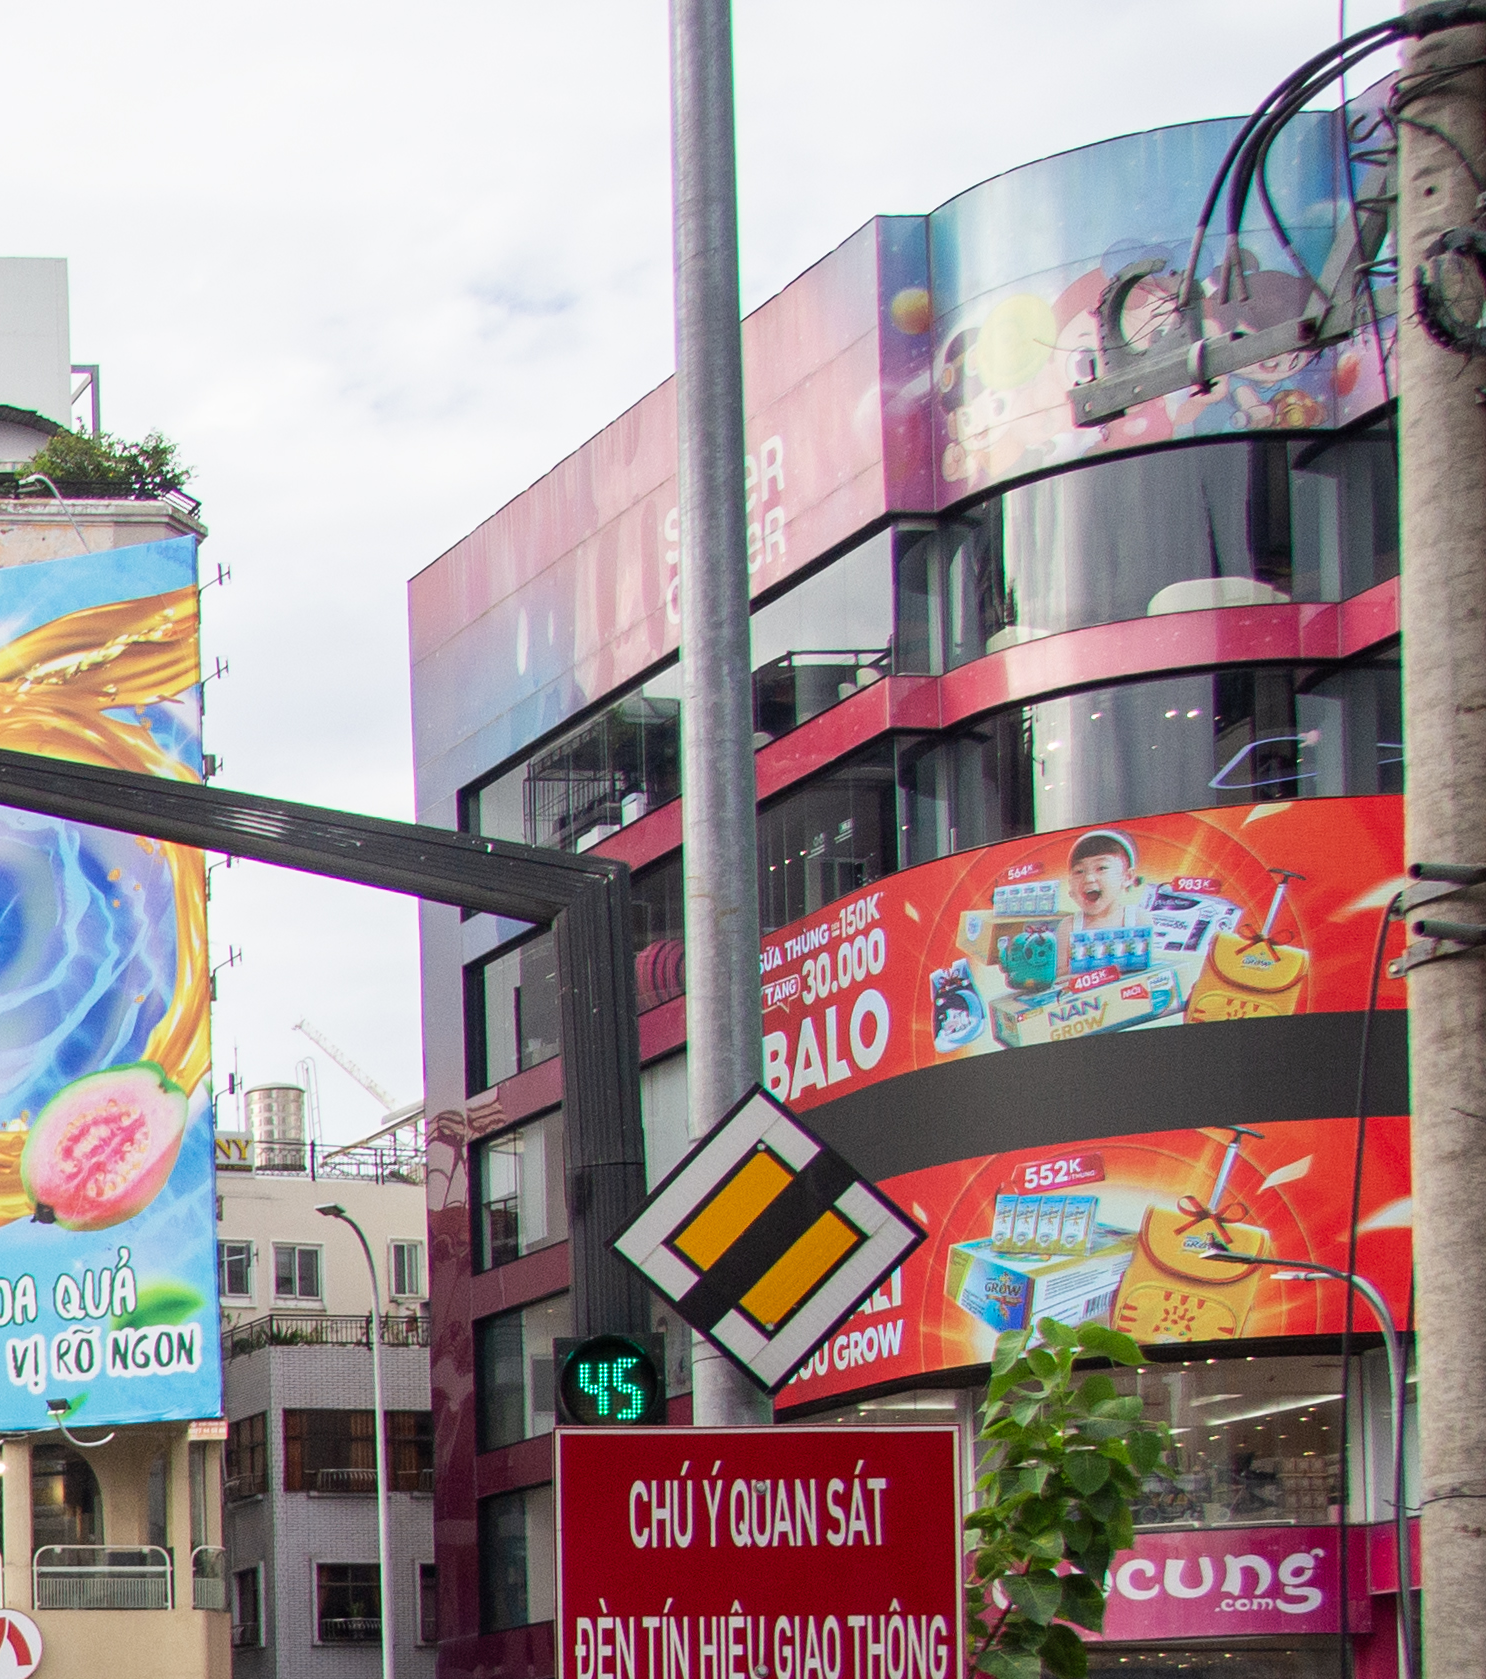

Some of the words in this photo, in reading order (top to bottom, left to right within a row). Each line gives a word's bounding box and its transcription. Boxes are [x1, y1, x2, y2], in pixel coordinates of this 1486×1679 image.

[785, 921, 829, 961] THÙNG
[801, 927, 886, 1005] 30.000
[762, 988, 890, 1103] BALO
[54, 1247, 138, 1322] QUẢ
[11, 1343, 42, 1390] VỊ
[56, 1330, 96, 1376] RÕ
[110, 1330, 196, 1375] NGON
[834, 1318, 904, 1372] GROW
[579, 1357, 645, 1421] 45
[629, 1460, 692, 1549] CHÚ
[702, 1460, 723, 1548] Ý
[729, 1477, 818, 1549] QUAN
[826, 1459, 888, 1547] SÁT
